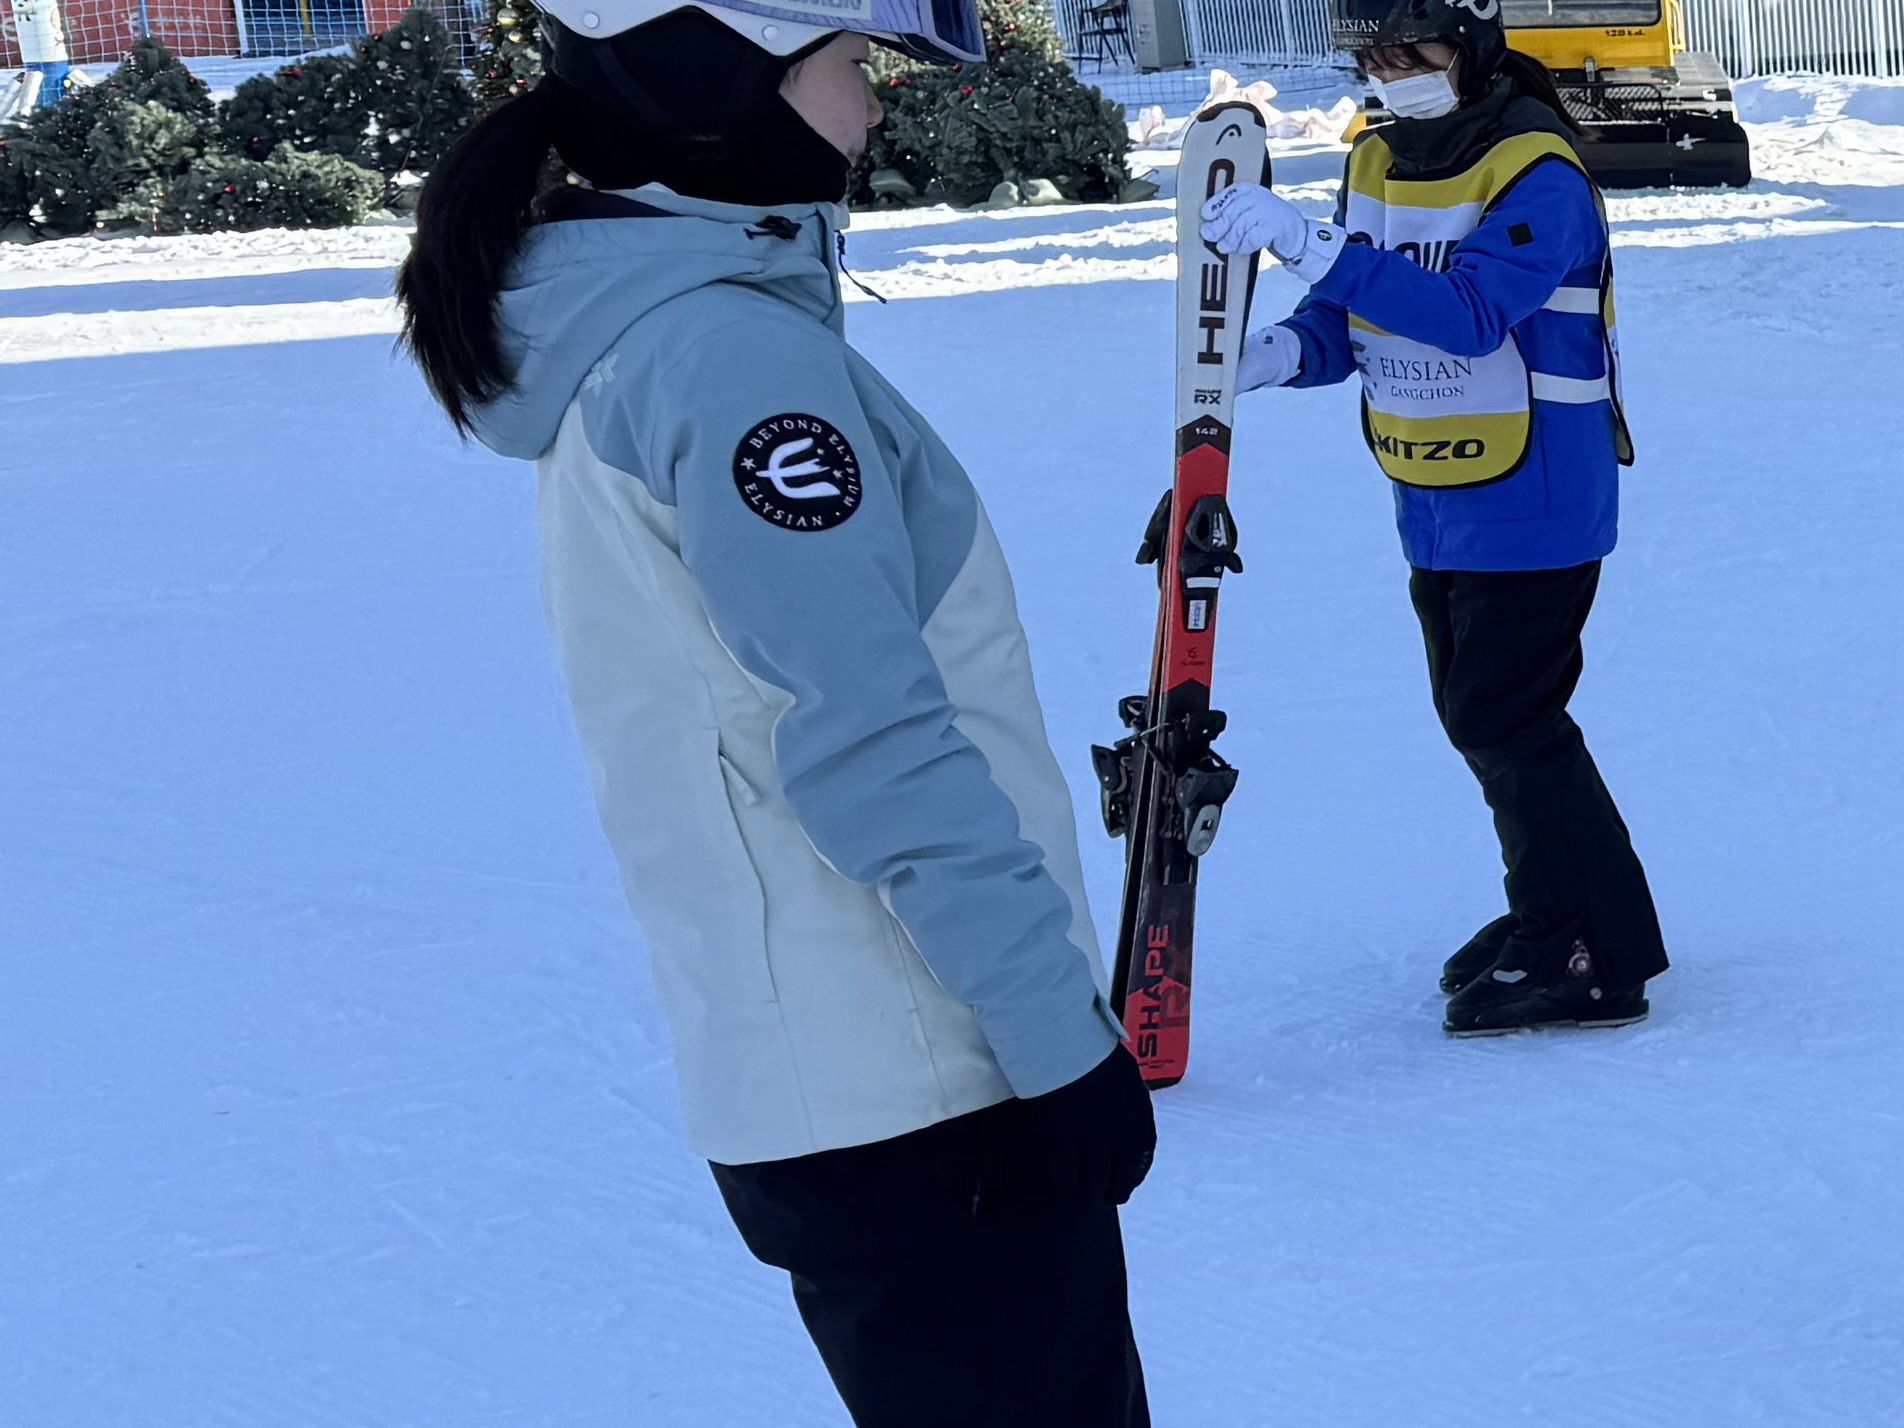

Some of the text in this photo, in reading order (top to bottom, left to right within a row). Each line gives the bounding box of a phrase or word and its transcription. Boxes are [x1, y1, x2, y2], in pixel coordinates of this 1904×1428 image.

[1380, 357, 1472, 381] ELYSIAN
[1194, 394, 1221, 404] RX
[1391, 385, 1464, 400] GANGCHON
[749, 419, 822, 449] BEYOND
[744, 483, 823, 527] ELYSIAN
[1137, 924, 1169, 1058] SHAPE
